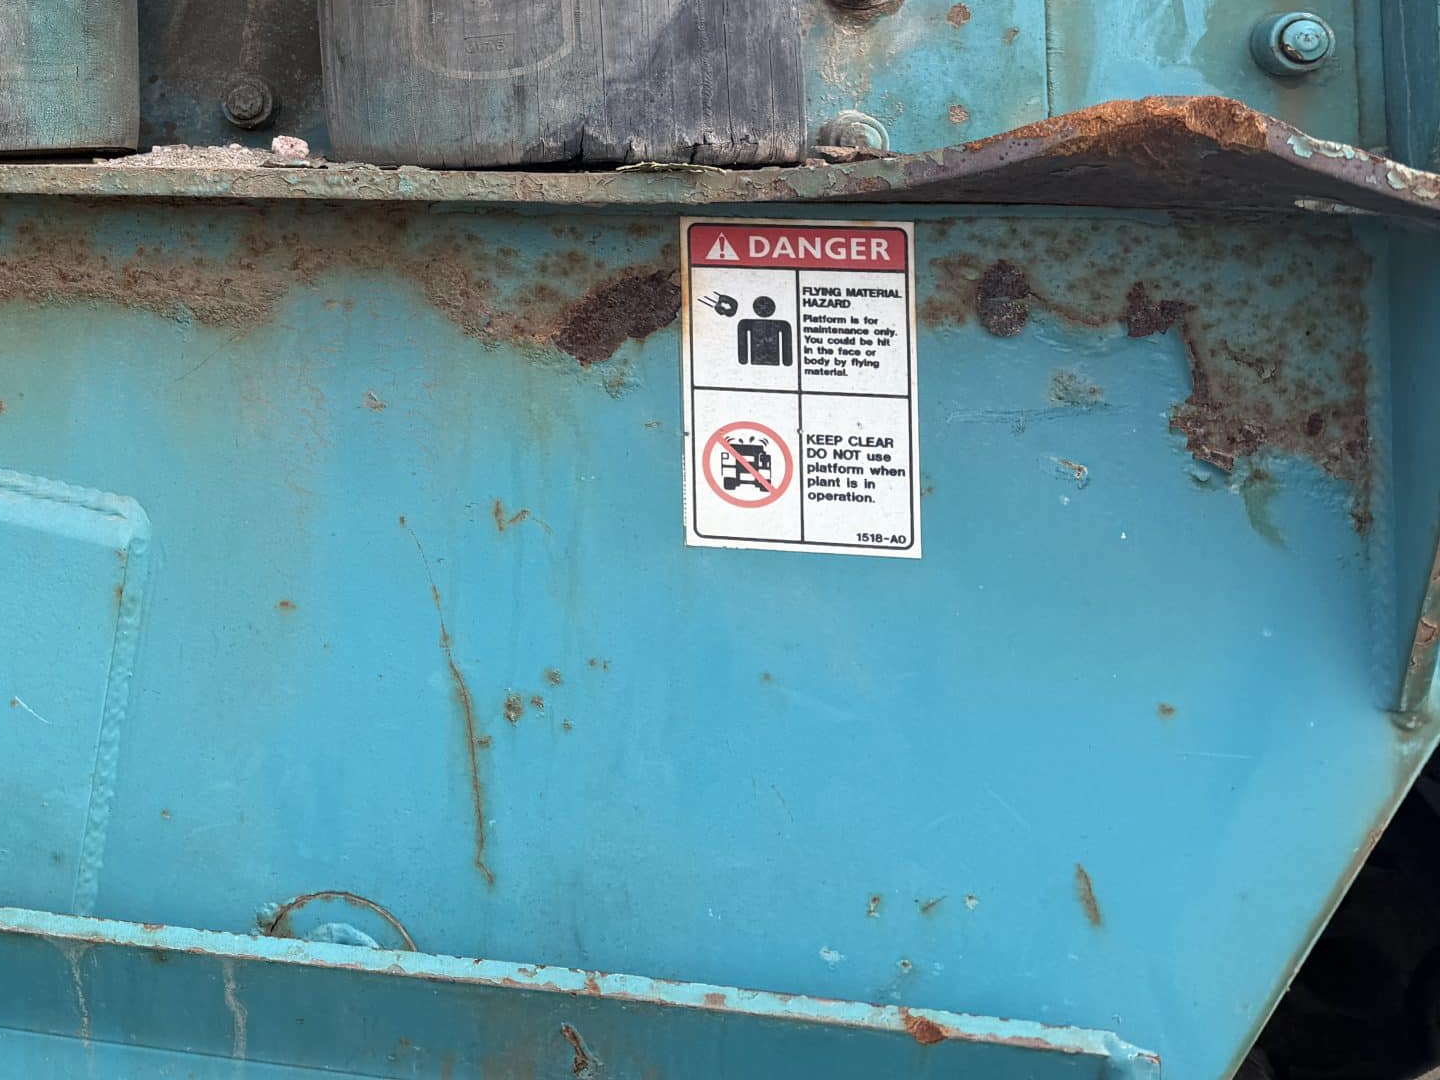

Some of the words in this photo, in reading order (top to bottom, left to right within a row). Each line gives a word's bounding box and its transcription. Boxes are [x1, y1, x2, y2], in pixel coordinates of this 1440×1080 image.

[749, 236, 890, 261] DANGER
[803, 287, 841, 297] FLYING
[846, 288, 902, 298] MATERIAL
[803, 298, 851, 308] HAZARD
[803, 314, 846, 323] Platform
[851, 316, 859, 324] is
[803, 326, 869, 336] maintenance
[874, 328, 898, 337] only.
[805, 335, 823, 344] You
[828, 337, 855, 345] could
[878, 338, 890, 346] hit
[804, 346, 813, 354] in
[817, 347, 833, 355] the
[838, 347, 861, 356] face
[804, 357, 830, 366] body
[834, 358, 846, 367] by
[852, 359, 879, 368] flying
[805, 368, 848, 377] material.
[807, 434, 842, 445] KEEP
[848, 436, 893, 448] CLEAR
[807, 448, 827, 459] DO
[833, 449, 861, 460] NOT
[867, 454, 891, 462] use
[807, 462, 863, 474] platform
[870, 466, 905, 476] when
[808, 476, 840, 488] plant
[847, 478, 857, 488] is
[864, 479, 875, 489] in
[808, 491, 876, 504] operation.
